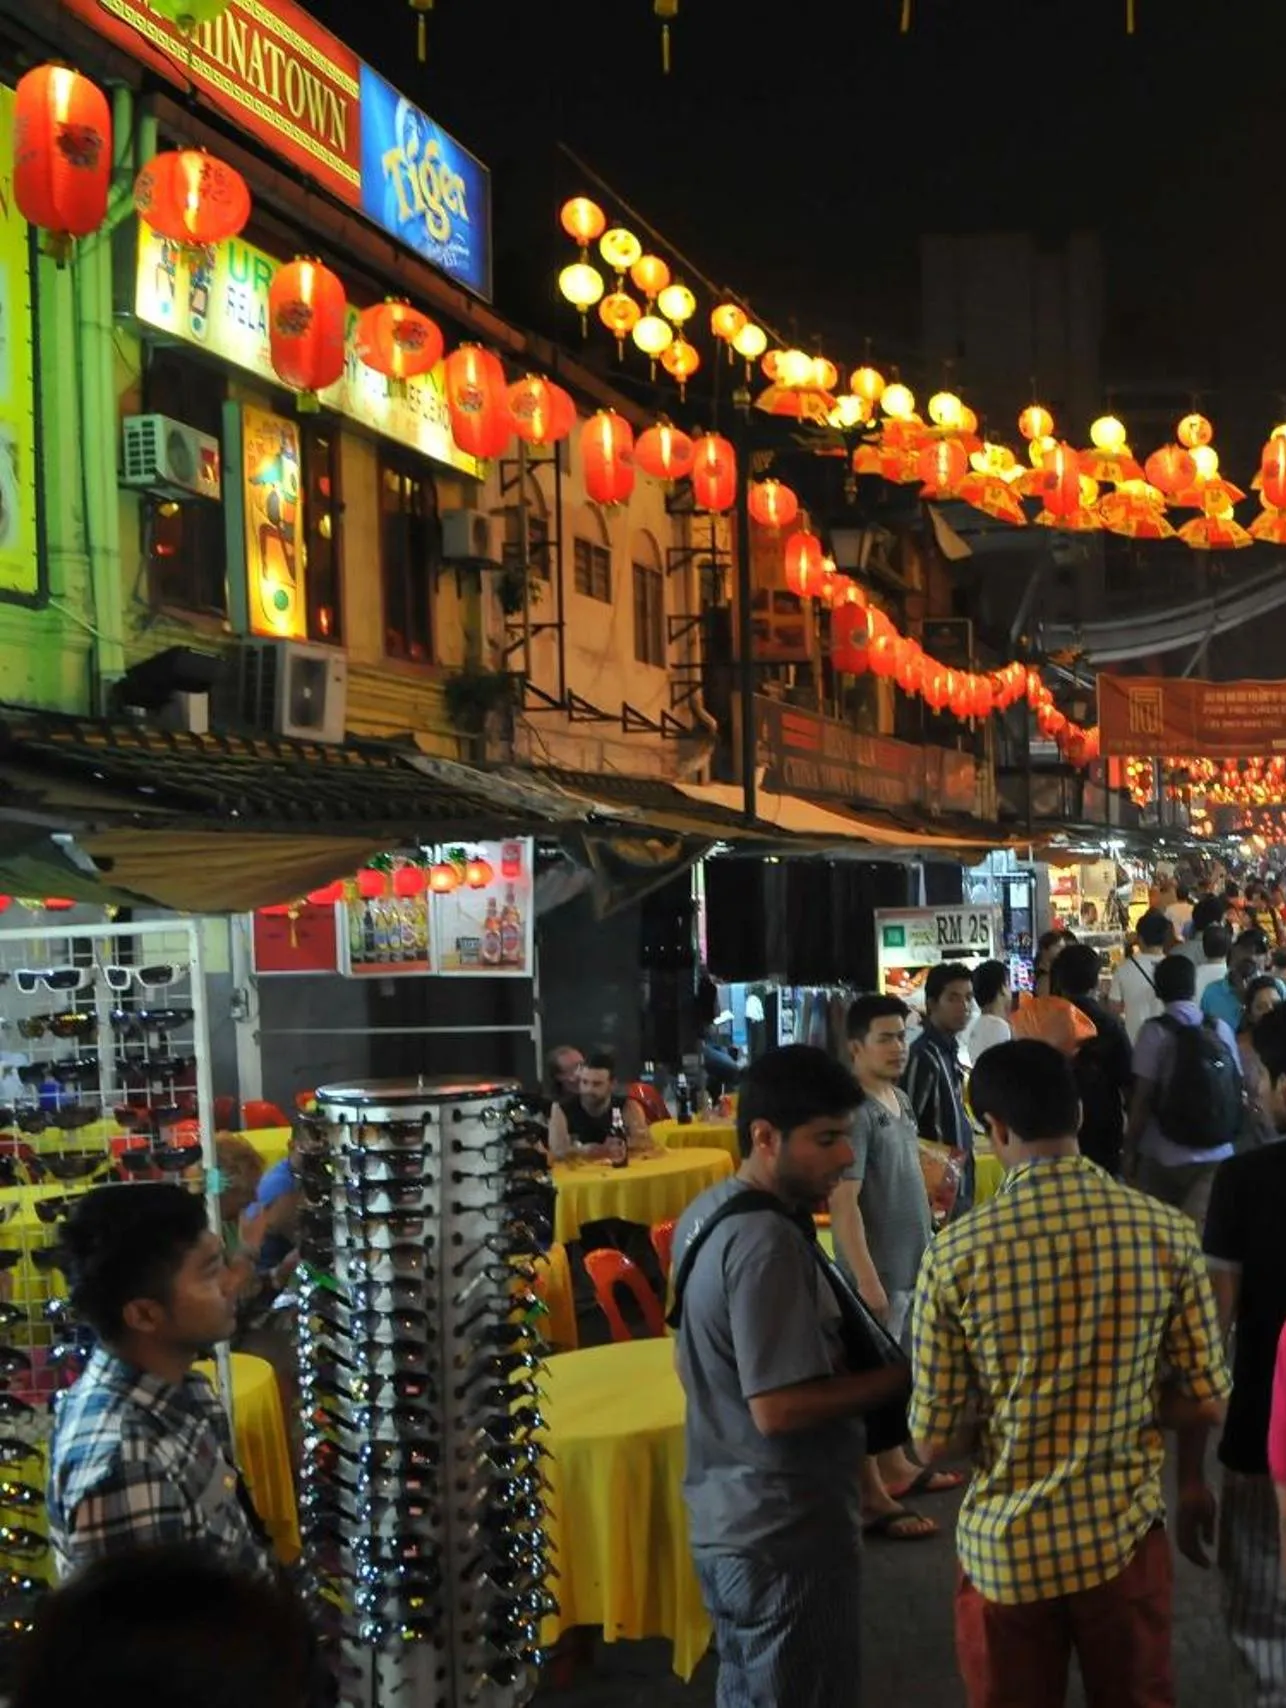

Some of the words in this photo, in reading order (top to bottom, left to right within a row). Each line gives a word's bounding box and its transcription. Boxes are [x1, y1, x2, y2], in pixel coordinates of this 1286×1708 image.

[184, 8, 347, 152] HINATOWN
[381, 139, 469, 241] Tiger
[936, 915, 963, 946] RM
[968, 913, 989, 943] 25
